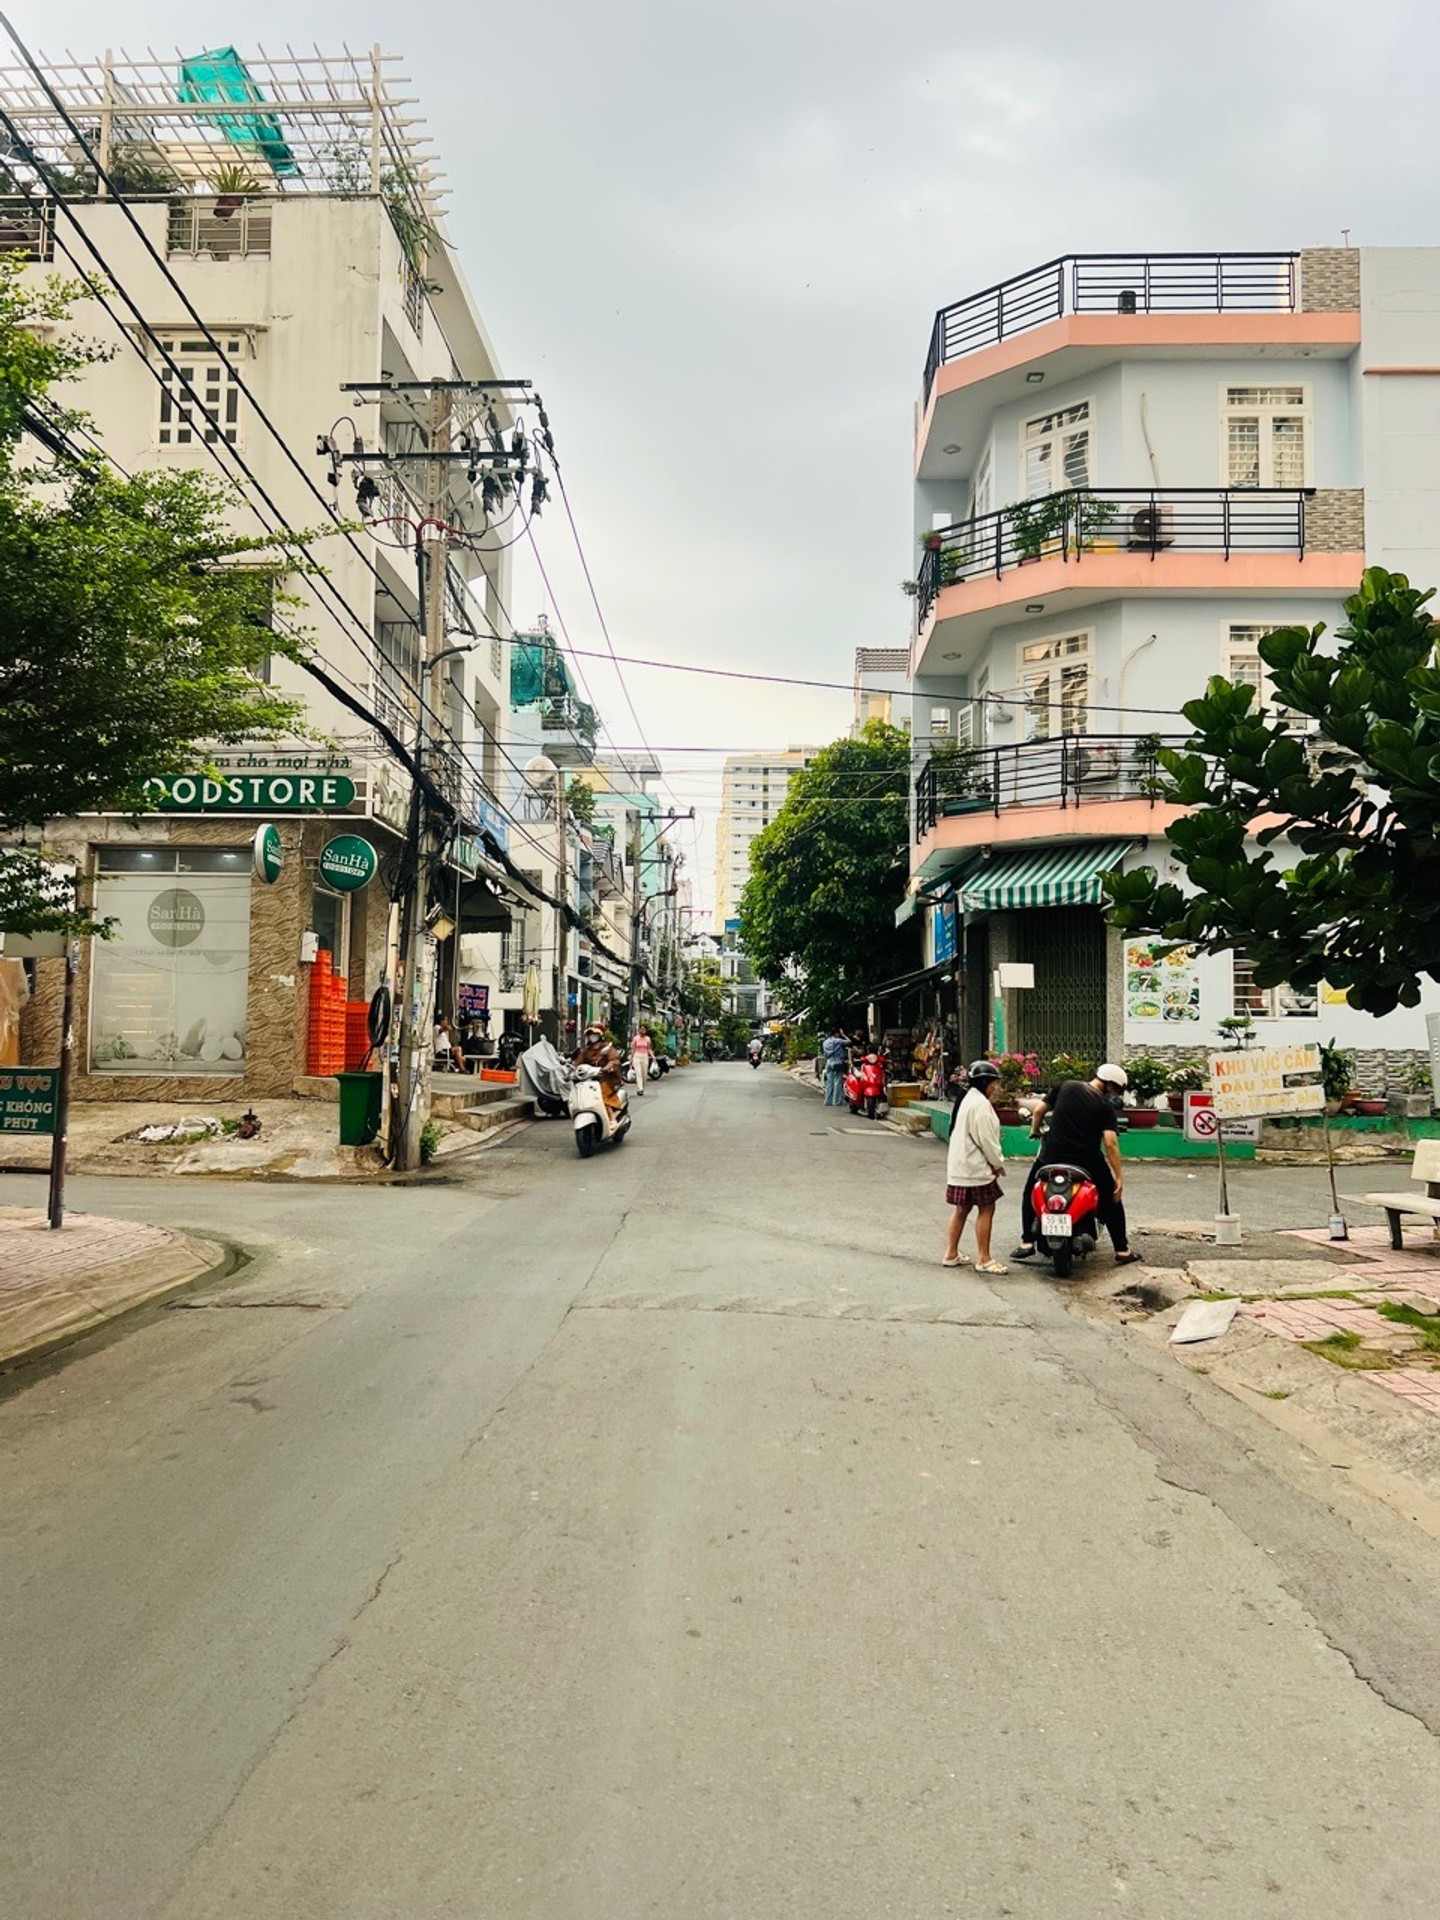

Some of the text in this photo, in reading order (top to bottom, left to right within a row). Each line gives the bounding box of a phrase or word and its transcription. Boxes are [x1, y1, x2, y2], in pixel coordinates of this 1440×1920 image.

[237, 754, 268, 768] cho
[276, 755, 308, 770] mọi
[142, 778, 337, 804] OODSTORE
[1215, 1059, 1246, 1077] KHU
[1261, 1078, 1280, 1090] XE
